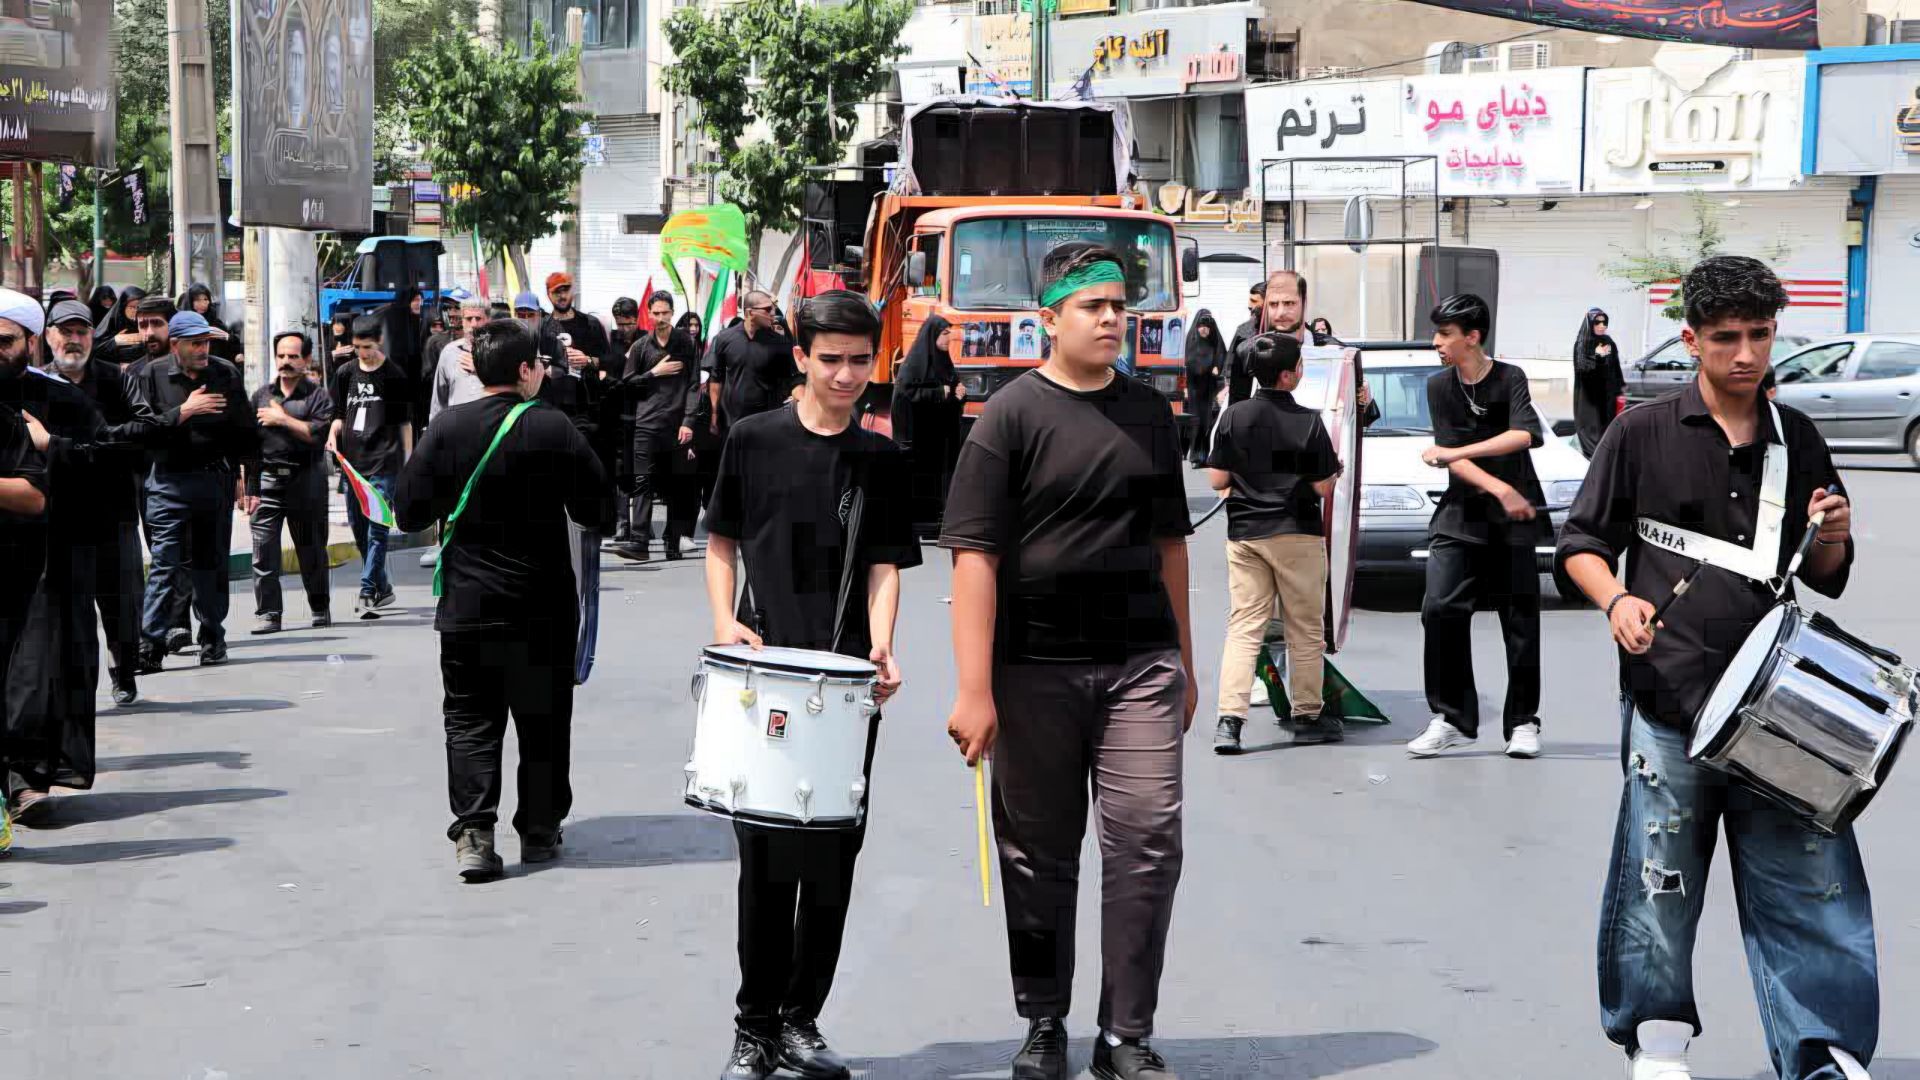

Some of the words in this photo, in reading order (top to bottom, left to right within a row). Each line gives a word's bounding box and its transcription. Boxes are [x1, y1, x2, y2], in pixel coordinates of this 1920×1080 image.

[1277, 95, 1366, 151] ترنم
[1424, 99, 1465, 132] مو
[1477, 82, 1549, 132] دنیای
